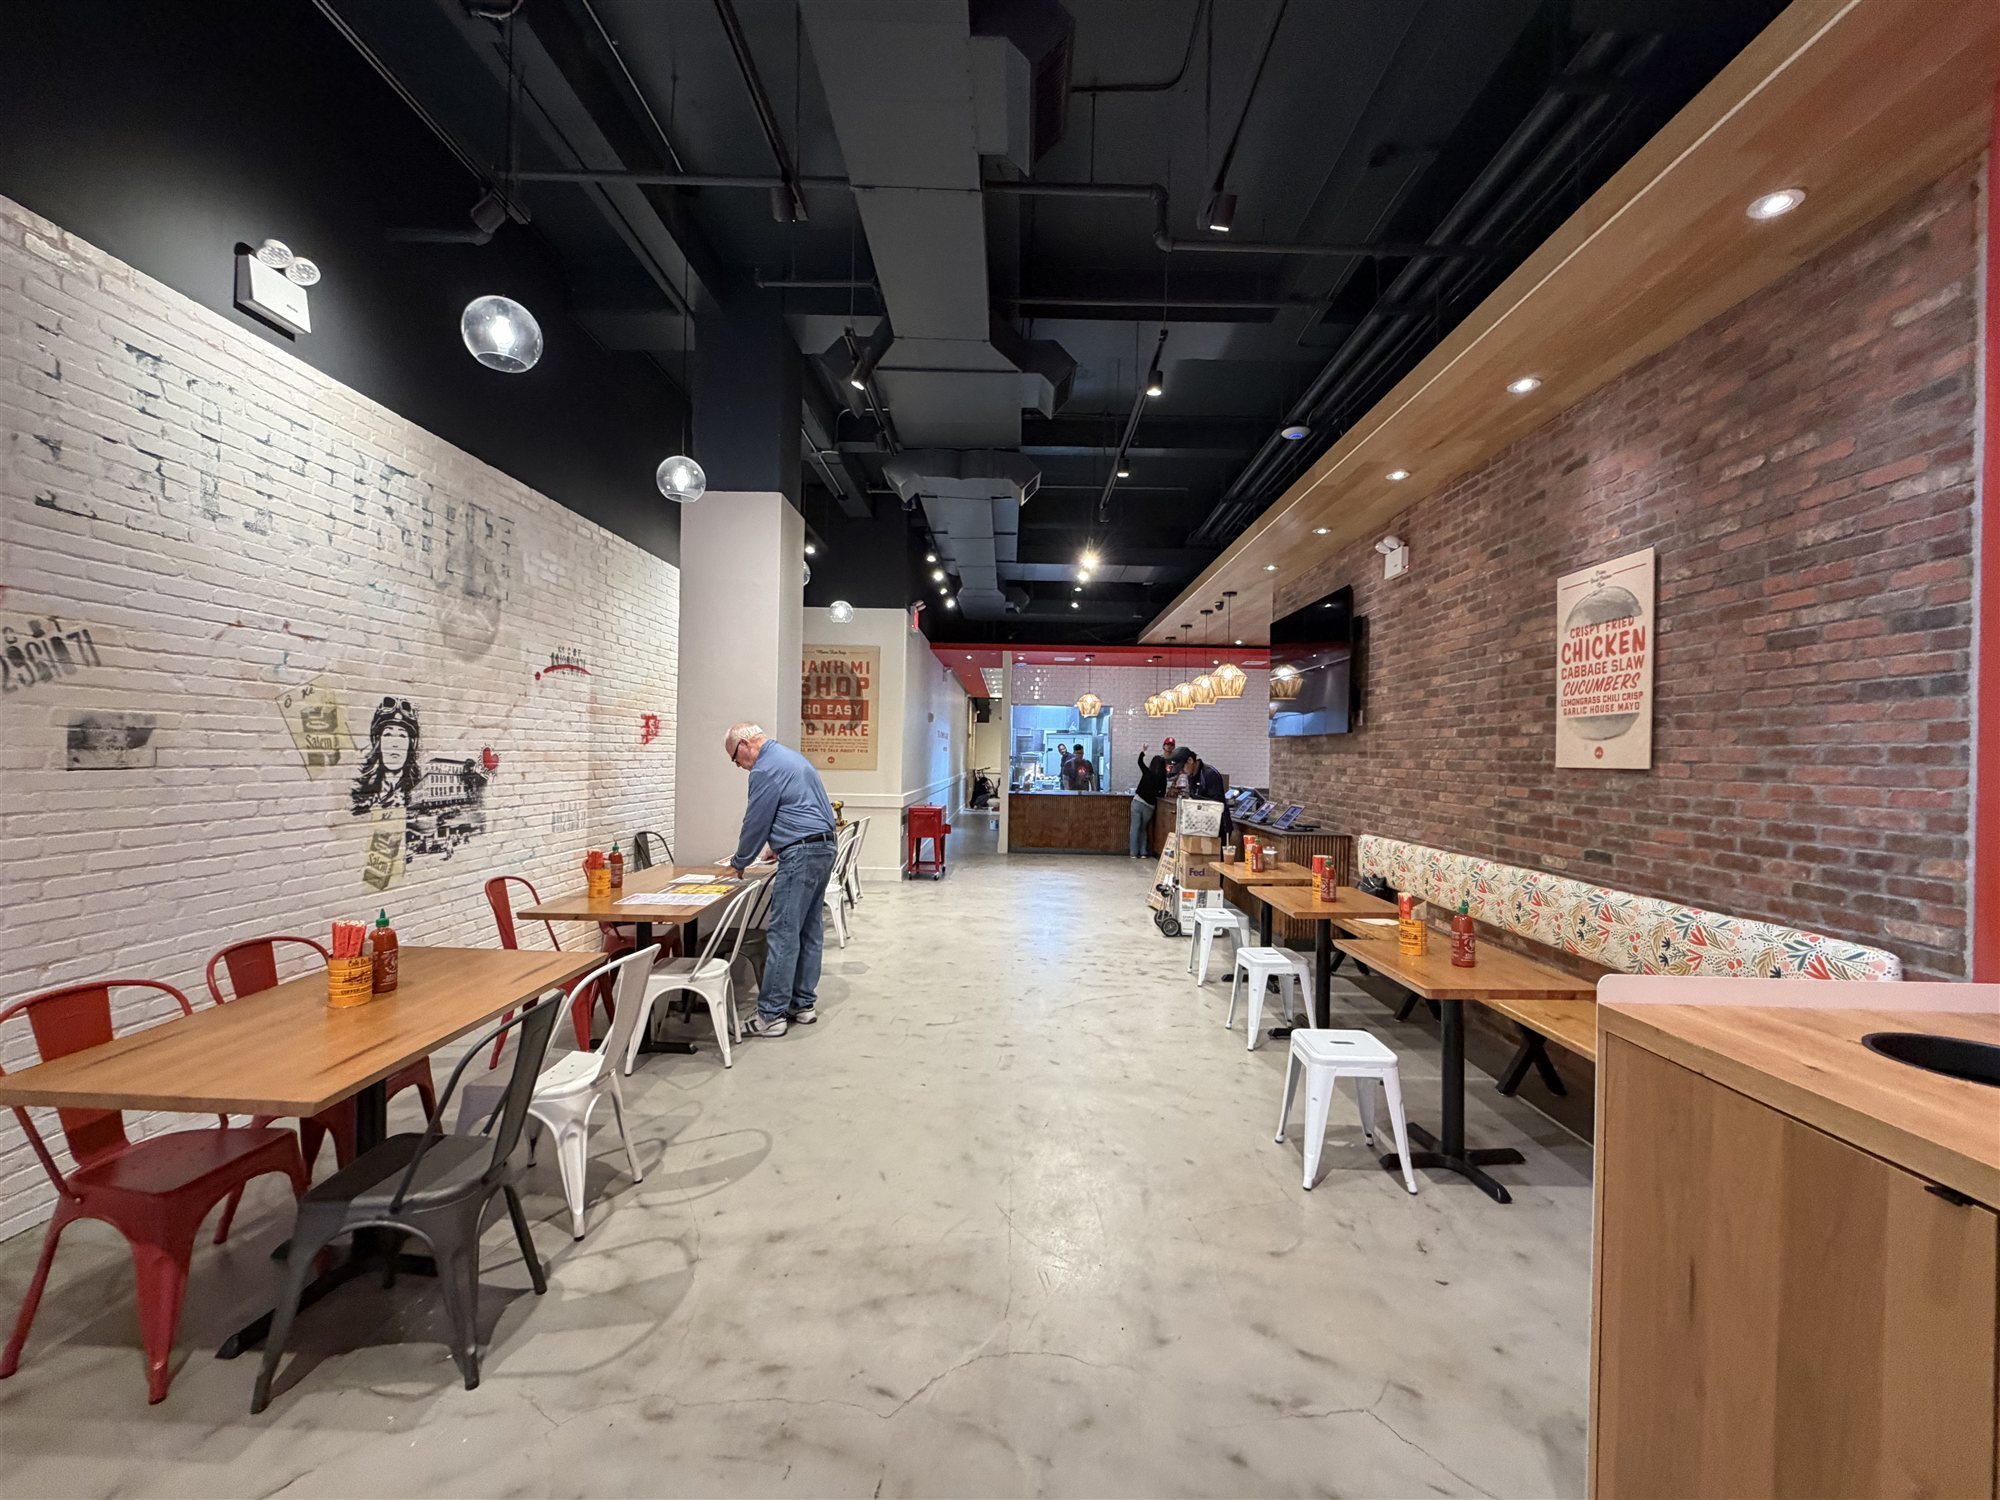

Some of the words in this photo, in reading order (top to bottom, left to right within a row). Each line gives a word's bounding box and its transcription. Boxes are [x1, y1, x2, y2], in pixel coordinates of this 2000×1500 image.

[1570, 622, 1600, 639] CRISPY
[1605, 615, 1634, 631] FRIED
[1561, 626, 1646, 665] CHICKEN
[852, 661, 870, 675] MI
[1561, 660, 1607, 681] CABBAGE
[1611, 654, 1645, 673] SLAW
[802, 676, 870, 696] SHOP
[1563, 672, 1641, 697] CUCUMBERS
[1561, 696, 1601, 707] LEMONGRASS
[1603, 693, 1620, 703] CHILI
[1622, 691, 1644, 702] CRISP
[803, 705, 821, 715] SO
[827, 705, 862, 715] EASY
[1563, 706, 1587, 716] GARLIC
[1589, 704, 1615, 714] HOUSE
[1617, 702, 1640, 712] MAYO
[824, 723, 869, 737] MAKE
